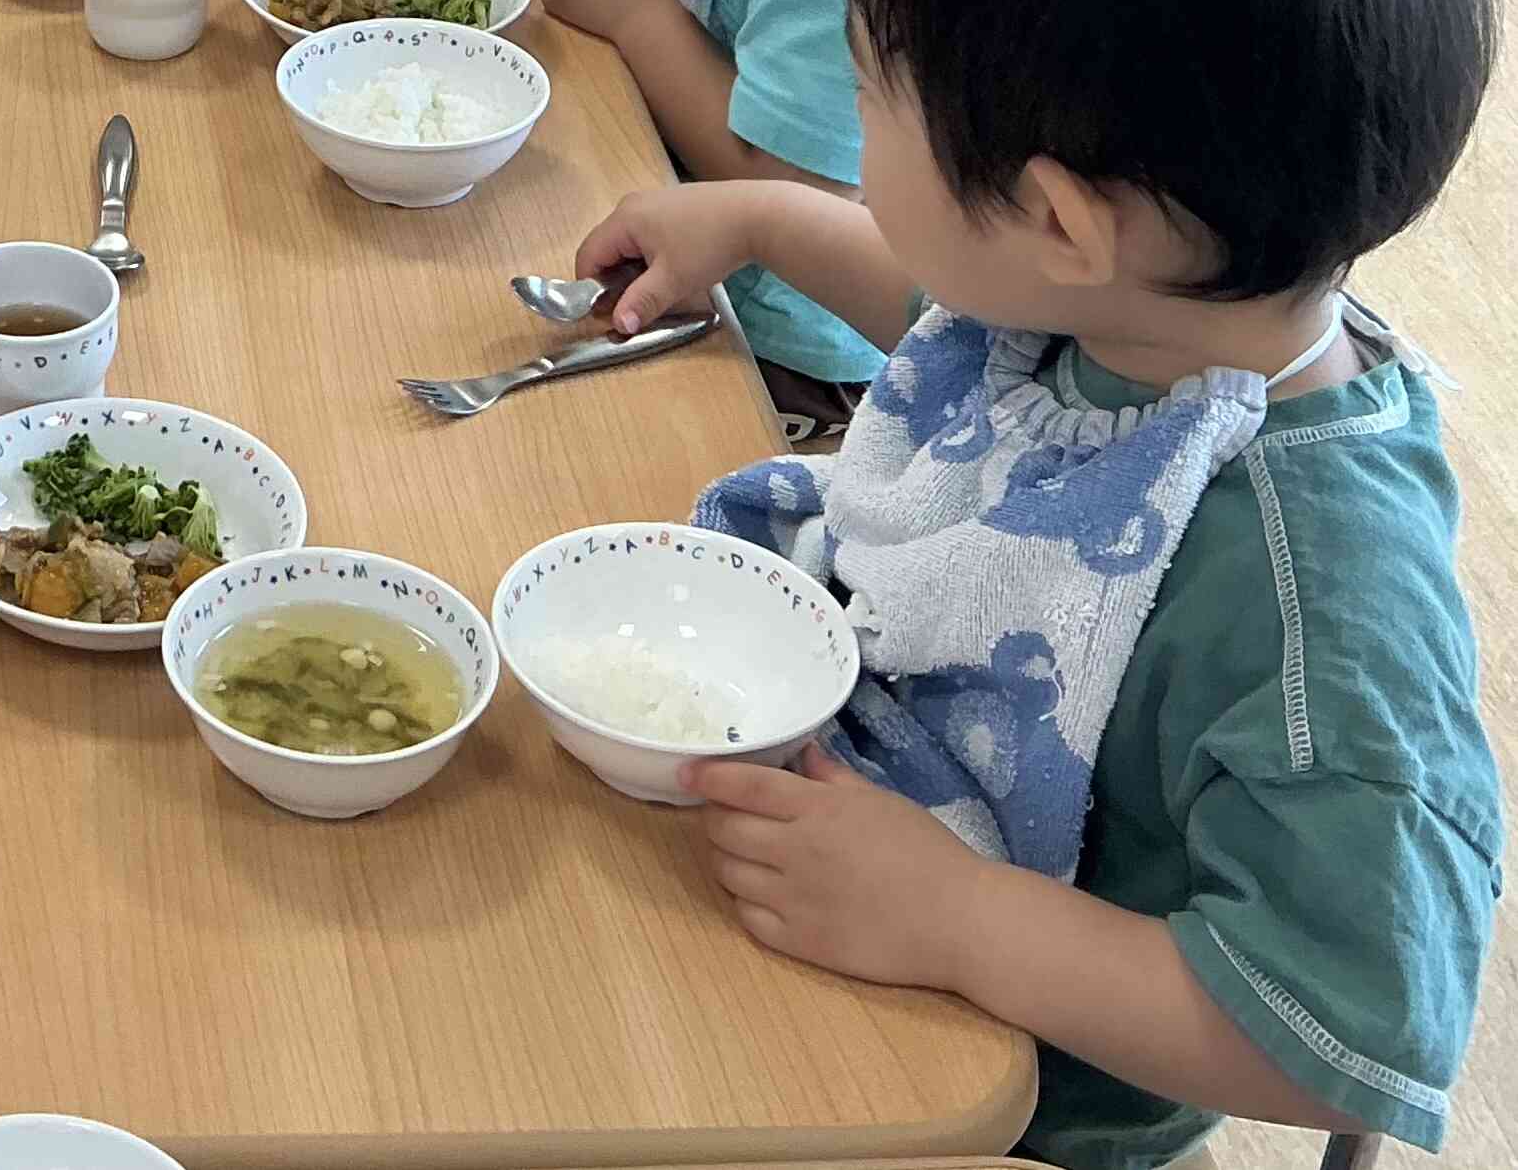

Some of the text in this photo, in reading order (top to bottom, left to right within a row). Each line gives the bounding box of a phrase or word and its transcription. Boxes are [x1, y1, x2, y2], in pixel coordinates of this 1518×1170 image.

[353, 31, 366, 43] Q
[438, 32, 449, 44] T
[34, 356, 47, 368] D
[20, 415, 31, 430] V
[101, 410, 115, 426] X
[179, 417, 191, 433] Z
[533, 564, 544, 582] X
[584, 536, 599, 554] Z
[626, 539, 637, 554] A
[658, 530, 670, 546] B
[691, 546, 705, 560] C
[730, 553, 744, 569] D
[766, 570, 781, 585] E
[221, 577, 233, 593] I
[251, 567, 262, 583] J
[284, 565, 297, 581] K
[353, 564, 368, 578] M
[393, 580, 409, 598] N
[425, 590, 439, 606] O
